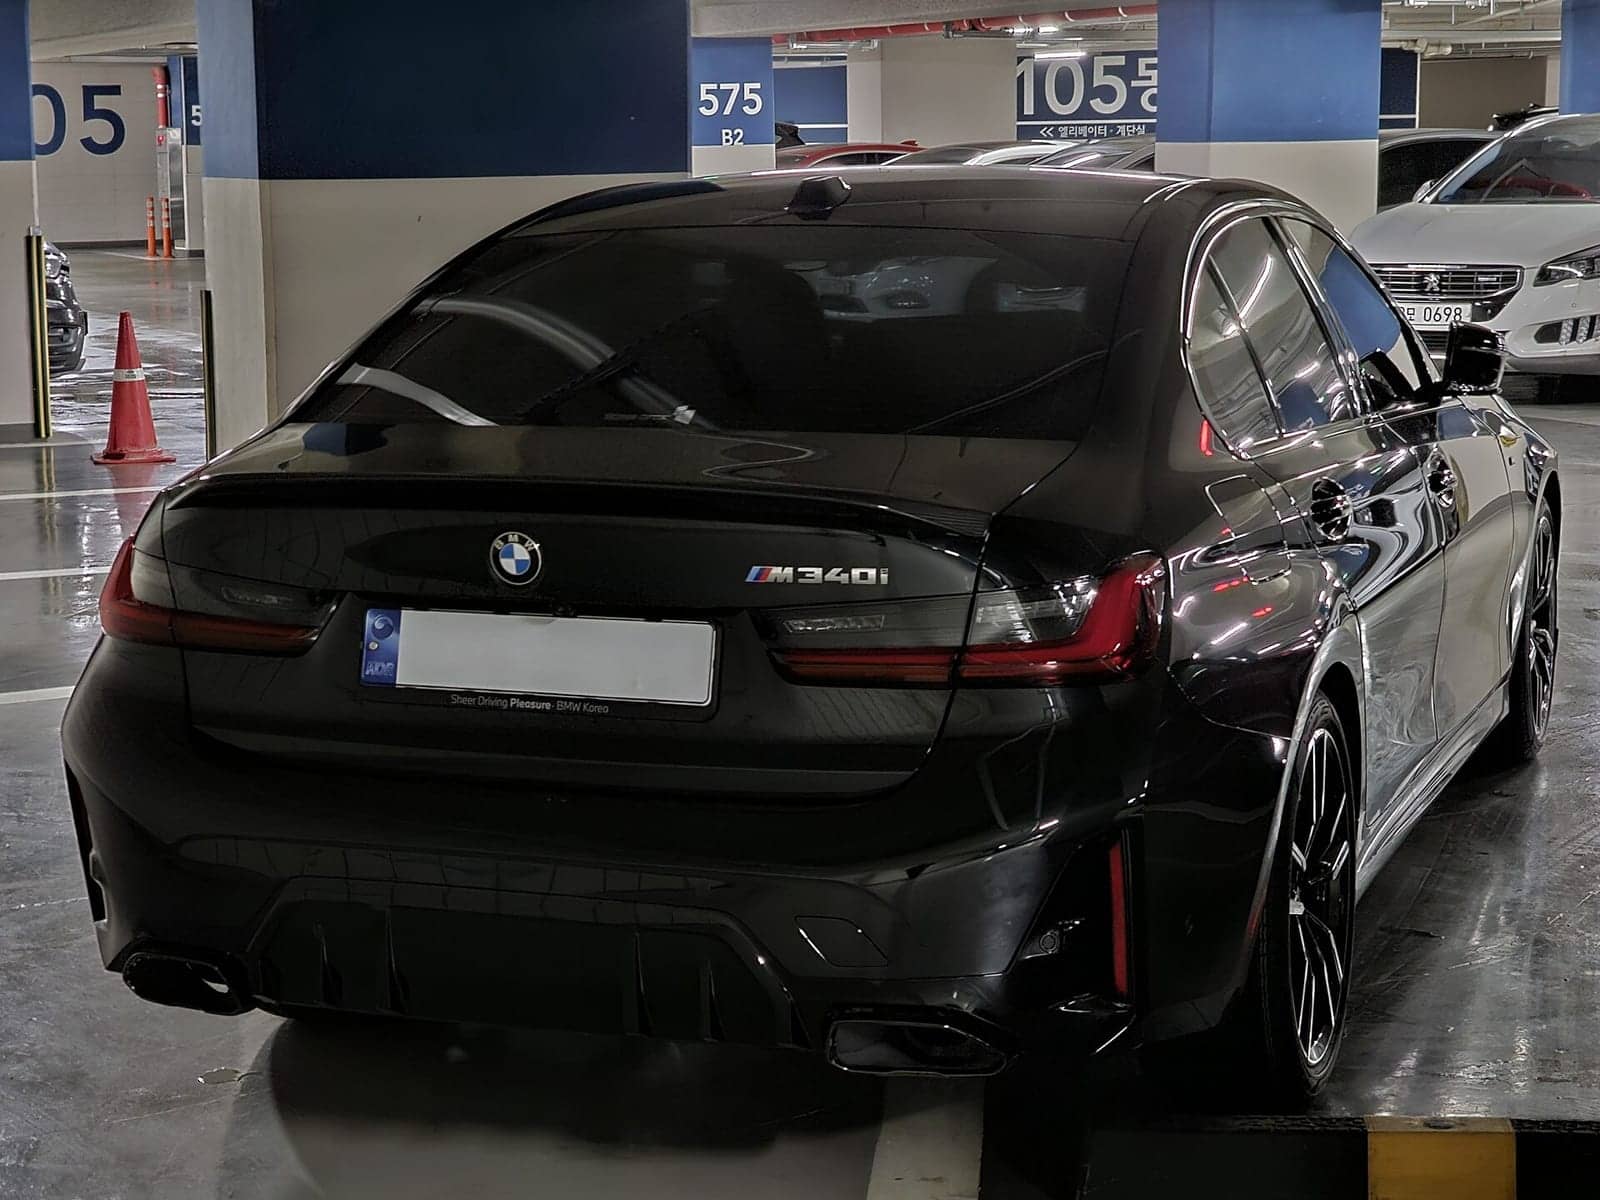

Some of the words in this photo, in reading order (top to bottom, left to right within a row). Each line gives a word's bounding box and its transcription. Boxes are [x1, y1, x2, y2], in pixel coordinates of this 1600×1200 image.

[698, 83, 763, 116] 575
[721, 128, 745, 146] B2
[1058, 125, 1107, 138] 엘리베이터
[1116, 124, 1145, 137] 계단실
[1423, 306, 1463, 322] 0698
[494, 534, 536, 552] BMW
[764, 566, 889, 585] M340i
[451, 693, 477, 706] Sheer
[478, 695, 508, 710] Driving
[510, 697, 552, 710] Pleasure
[556, 700, 581, 712] BMW
[583, 702, 609, 714] Korea
